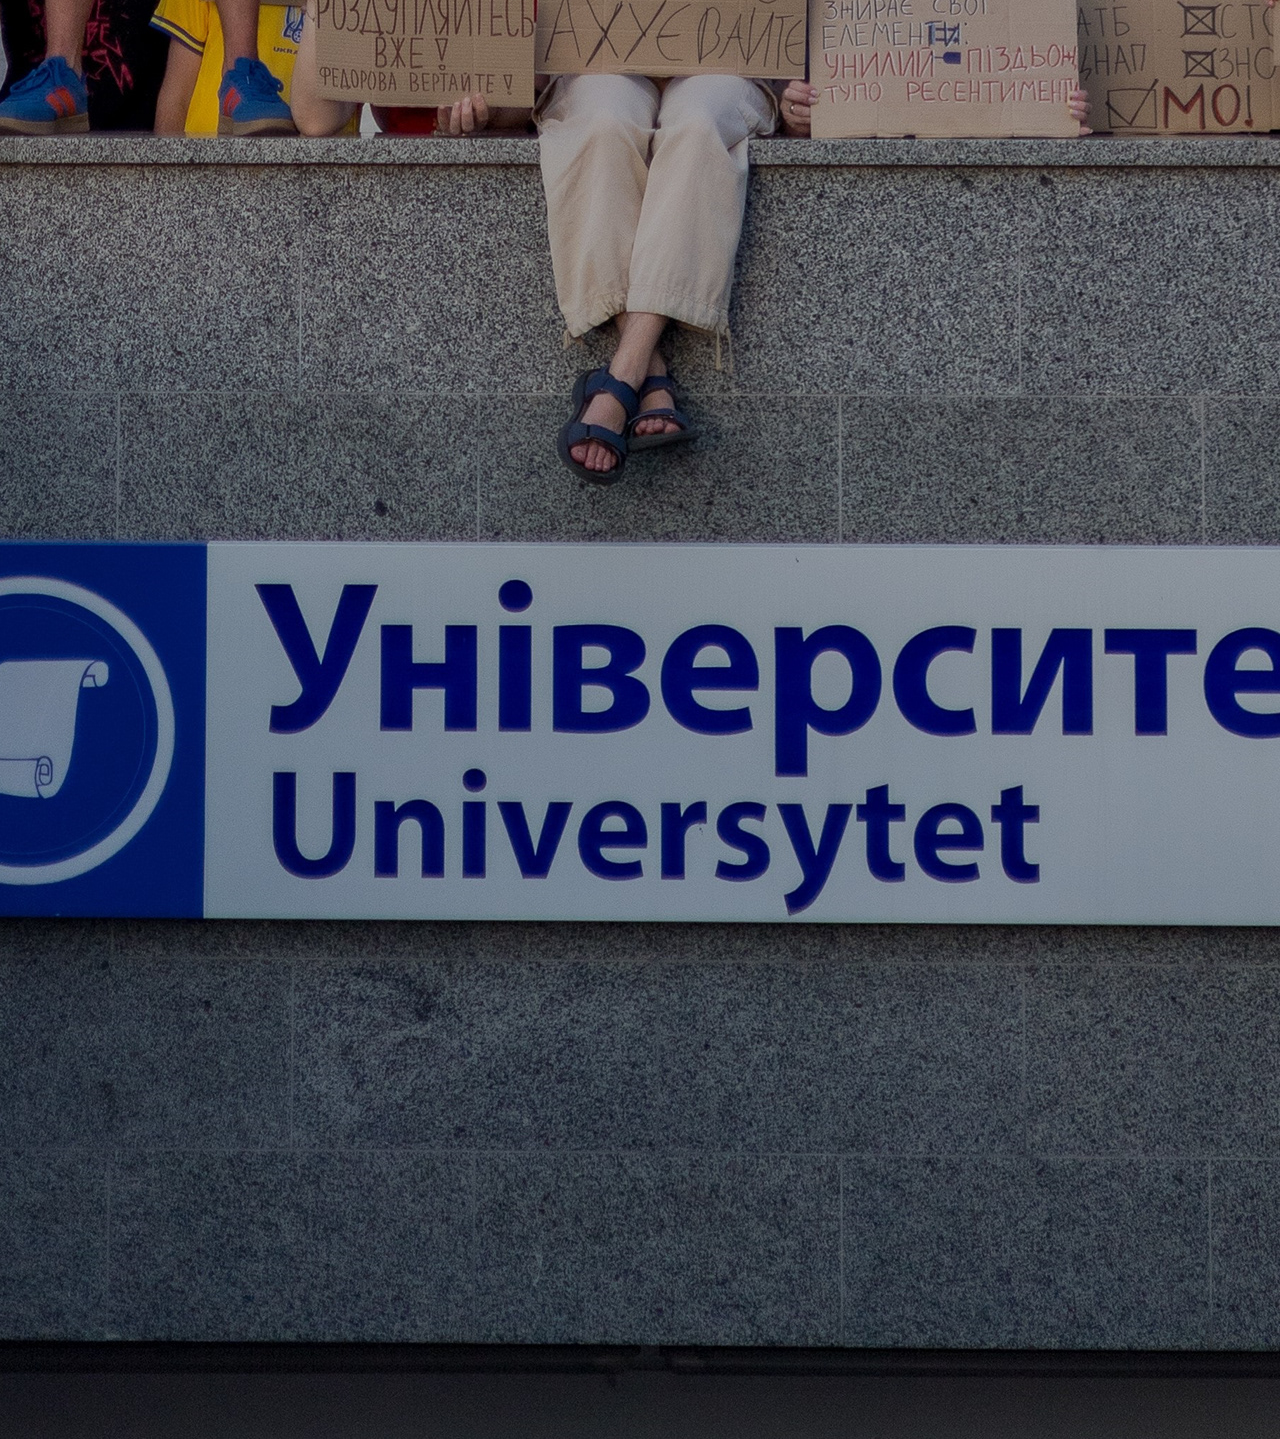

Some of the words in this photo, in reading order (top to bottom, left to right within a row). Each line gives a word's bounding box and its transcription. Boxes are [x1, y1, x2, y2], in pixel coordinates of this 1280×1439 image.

[375, 37, 424, 69] ВЖЕ
[824, 46, 935, 81] УНИЛИЙ
[319, 67, 397, 92] ФЕДОРОВА
[409, 71, 495, 95] ВЕРТАЙТЕ
[824, 81, 882, 103] ТУПО
[272, 767, 1041, 916] Universytet
